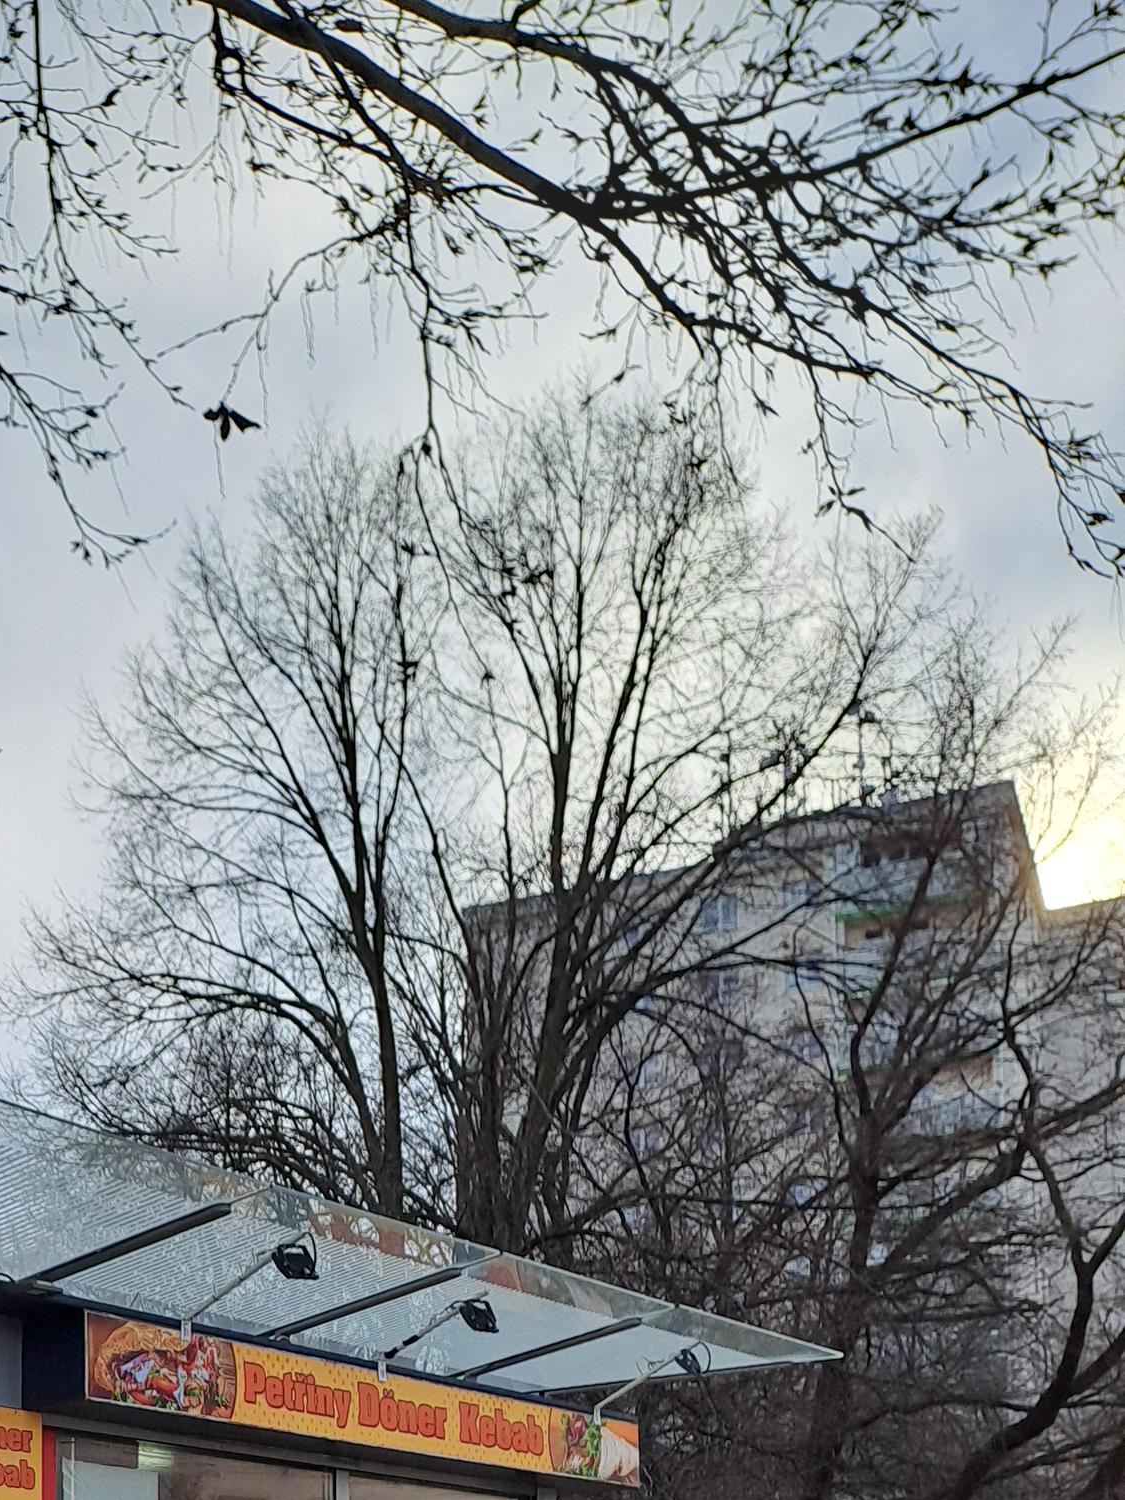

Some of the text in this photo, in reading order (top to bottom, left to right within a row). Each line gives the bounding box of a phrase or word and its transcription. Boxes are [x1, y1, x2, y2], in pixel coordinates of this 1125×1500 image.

[242, 1361, 545, 1456] Petřiny Döner Kebab
